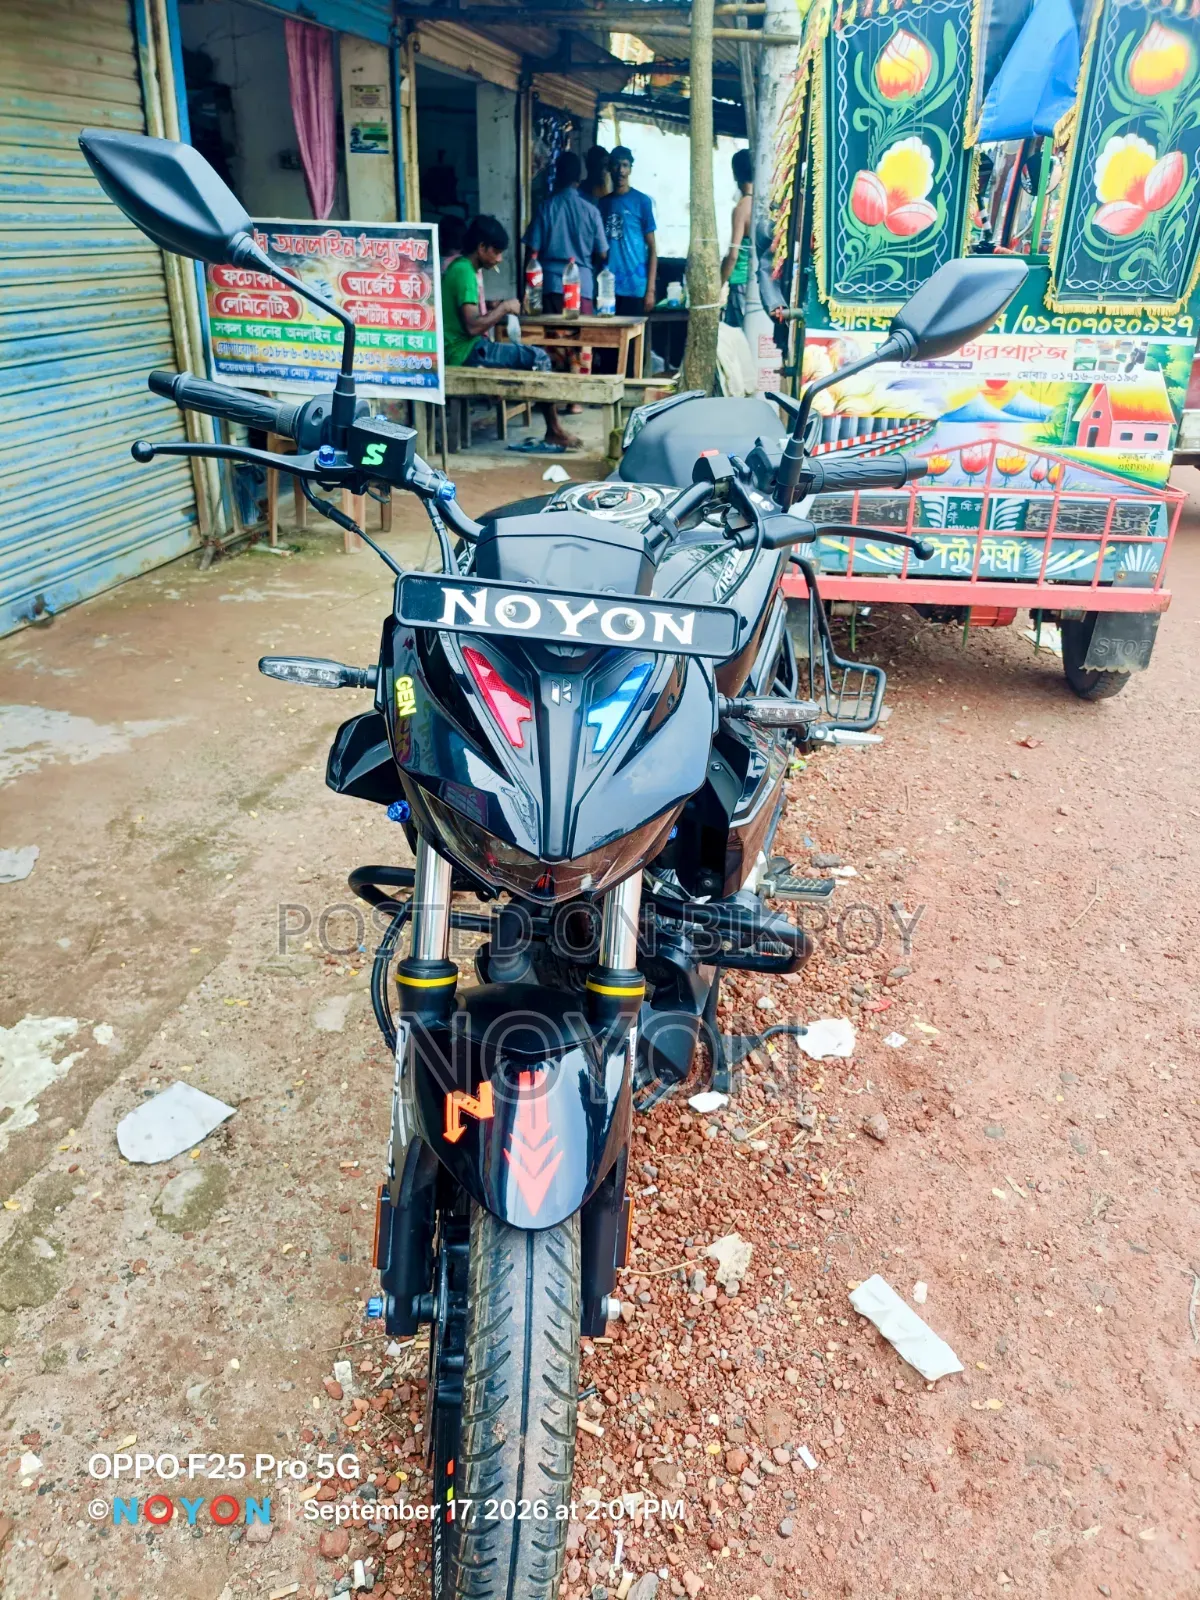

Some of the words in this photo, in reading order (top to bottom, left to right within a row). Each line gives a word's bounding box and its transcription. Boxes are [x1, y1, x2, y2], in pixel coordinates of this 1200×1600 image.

[271, 229, 356, 258] অনলাইন
[437, 587, 697, 645] NOYON
[395, 675, 417, 717] GEN
